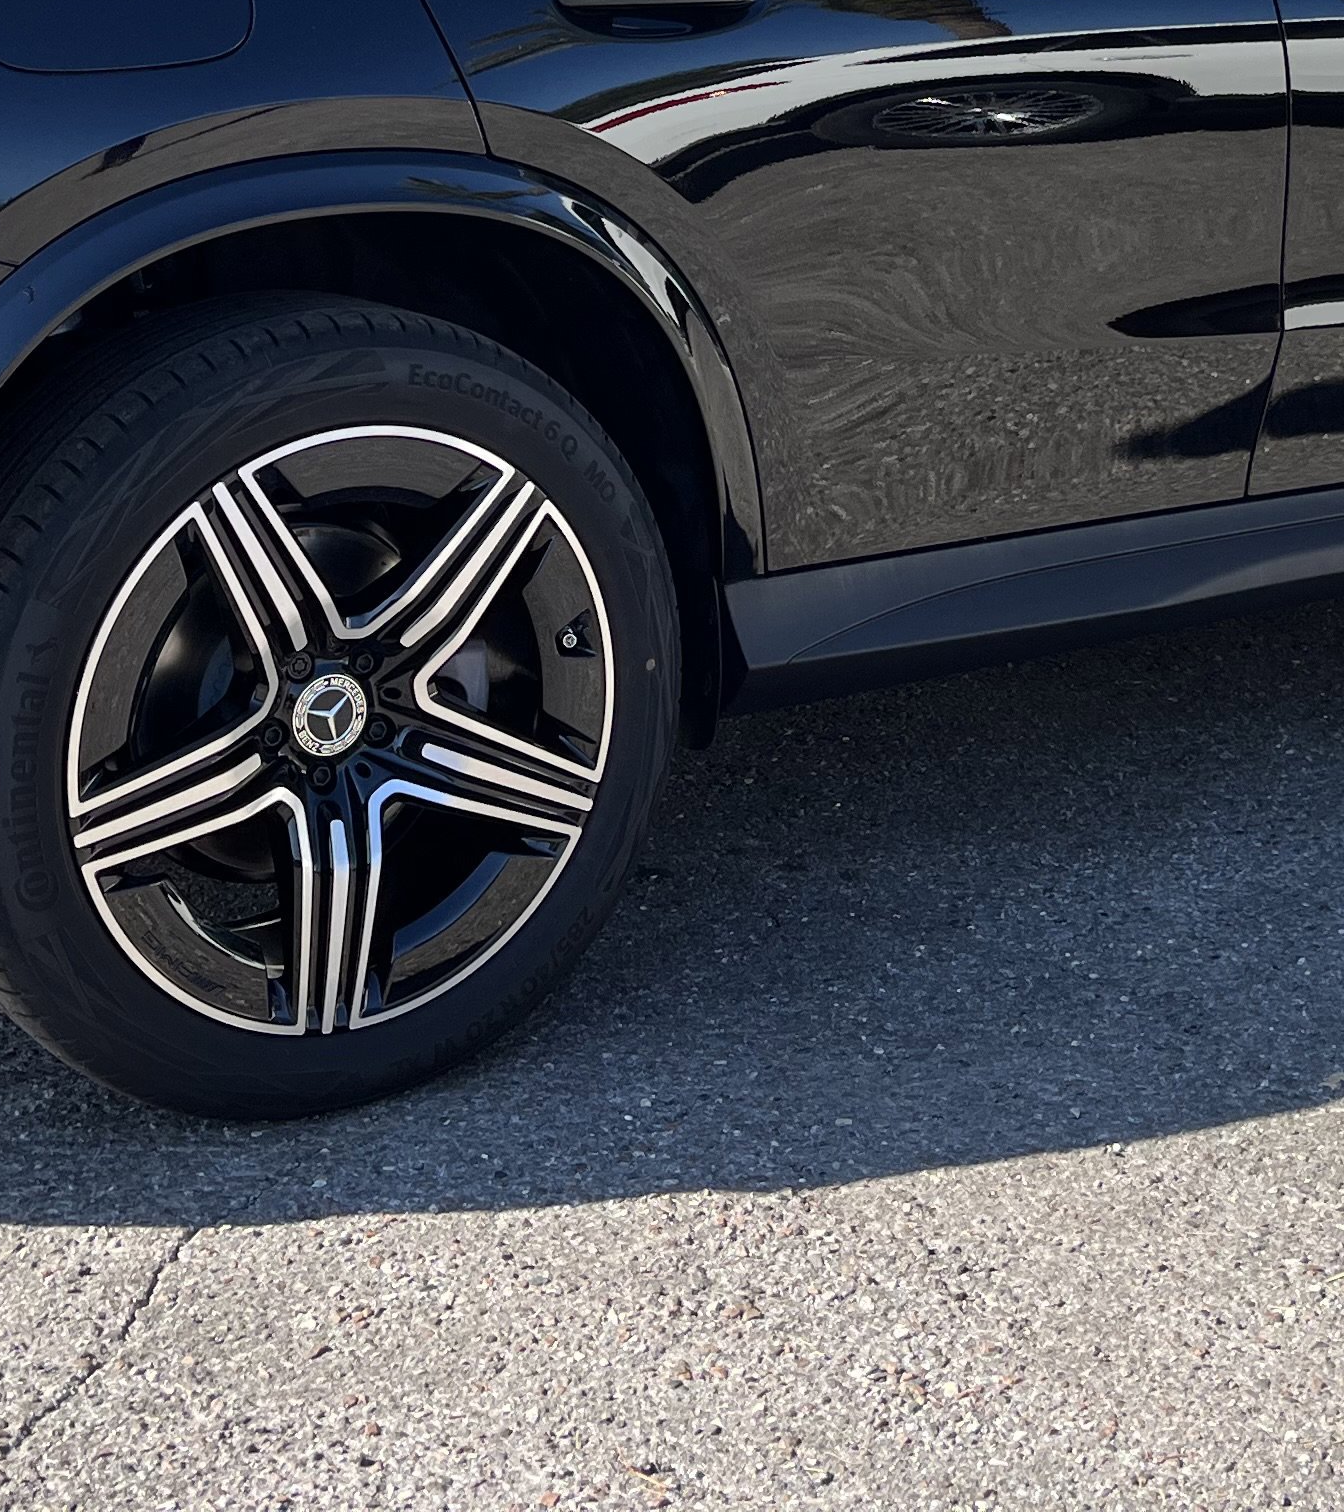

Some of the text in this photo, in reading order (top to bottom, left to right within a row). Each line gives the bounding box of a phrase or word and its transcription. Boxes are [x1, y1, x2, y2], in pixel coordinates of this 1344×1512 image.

[407, 362, 543, 431] EcoContact
[583, 460, 616, 502] MO
[330, 677, 365, 714] MERCEDES
[298, 730, 320, 752] BENZ
[2, 671, 60, 914] Continental
